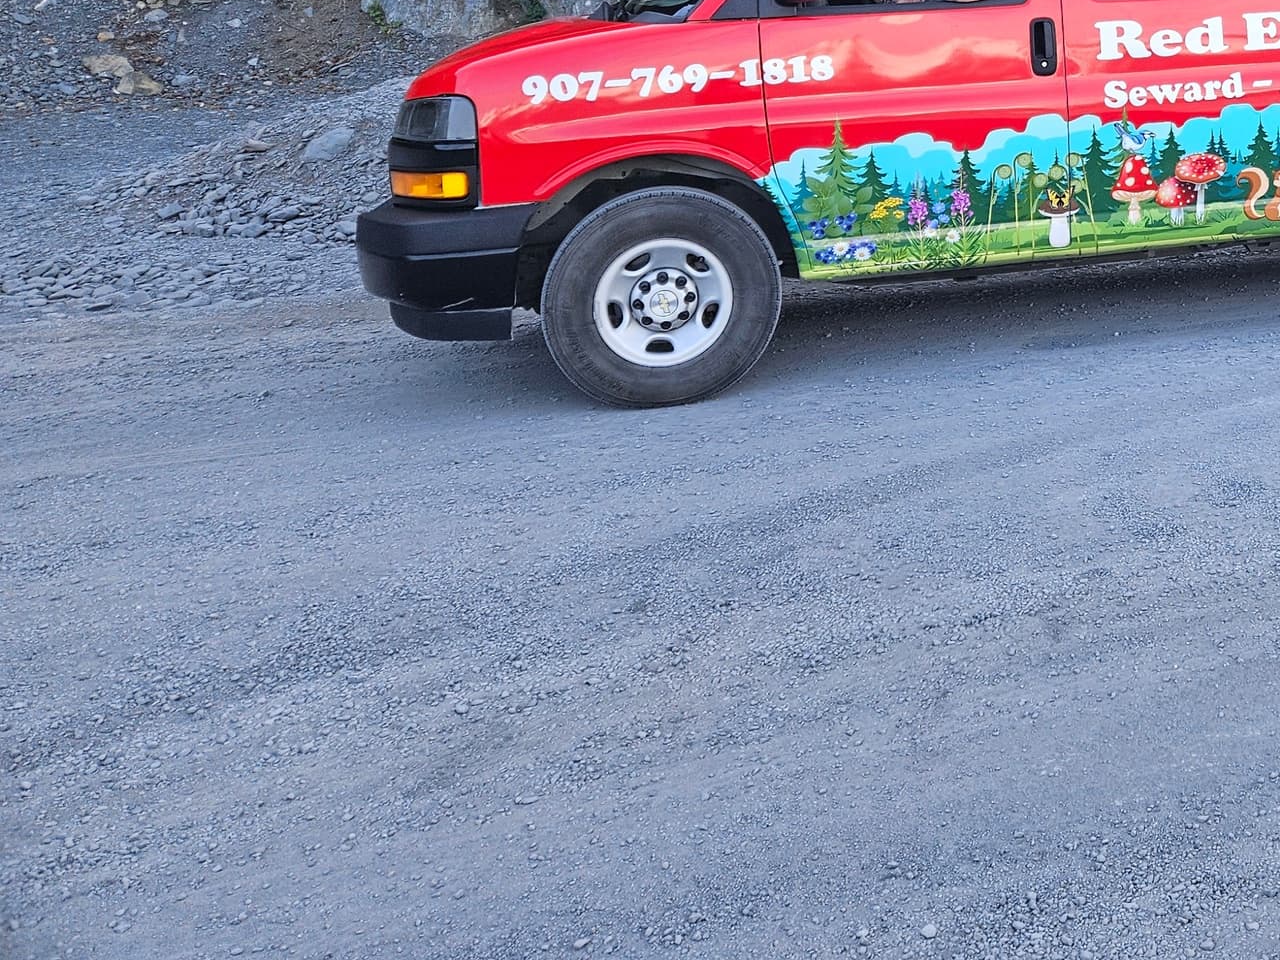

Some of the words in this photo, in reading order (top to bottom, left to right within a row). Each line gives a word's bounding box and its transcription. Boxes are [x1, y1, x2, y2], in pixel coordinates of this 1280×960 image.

[1094, 15, 1230, 61] Red
[521, 55, 834, 104] 907-769-1818
[1103, 72, 1243, 109] Seward
